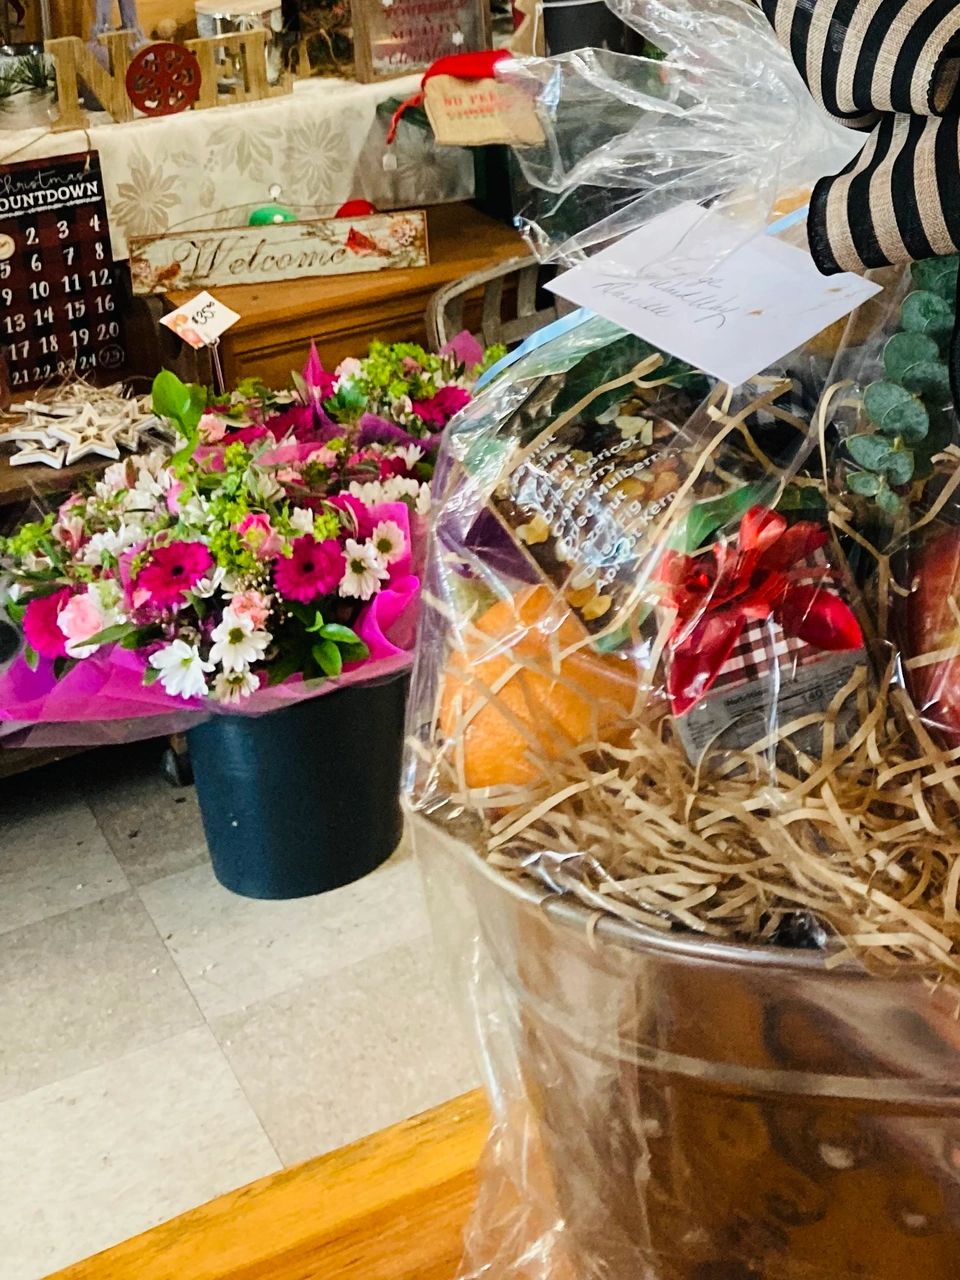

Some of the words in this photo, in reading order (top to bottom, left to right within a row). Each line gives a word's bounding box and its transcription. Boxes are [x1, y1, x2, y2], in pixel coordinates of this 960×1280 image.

[0, 181, 99, 211] OUNTDOWN
[25, 227, 39, 245] 2
[57, 220, 69, 239] 3
[89, 214, 100, 231] 4
[0, 261, 11, 278] 5
[31, 254, 42, 271] 6
[63, 247, 74, 265] 7
[95, 242, 104, 259] 8
[172, 236, 347, 279] Welcome
[2, 288, 12, 306] 9
[29, 281, 49, 299] 10
[61, 274, 81, 293] 11
[89, 268, 112, 287] 12
[4, 314, 26, 333] 13
[34, 306, 54, 326] 14
[64, 300, 86, 320] 15
[95, 294, 114, 313] 16
[9, 340, 30, 360] 17
[40, 334, 58, 354] 18
[69, 328, 89, 347] 19
[97, 322, 119, 340] 20
[12, 369, 29, 385] 21
[33, 364, 51, 381] 22
[80, 353, 97, 369] 24
[574, 435, 641, 477] Apricot
[592, 451, 664, 503] Mulberr
[552, 461, 617, 538] Cranberry
